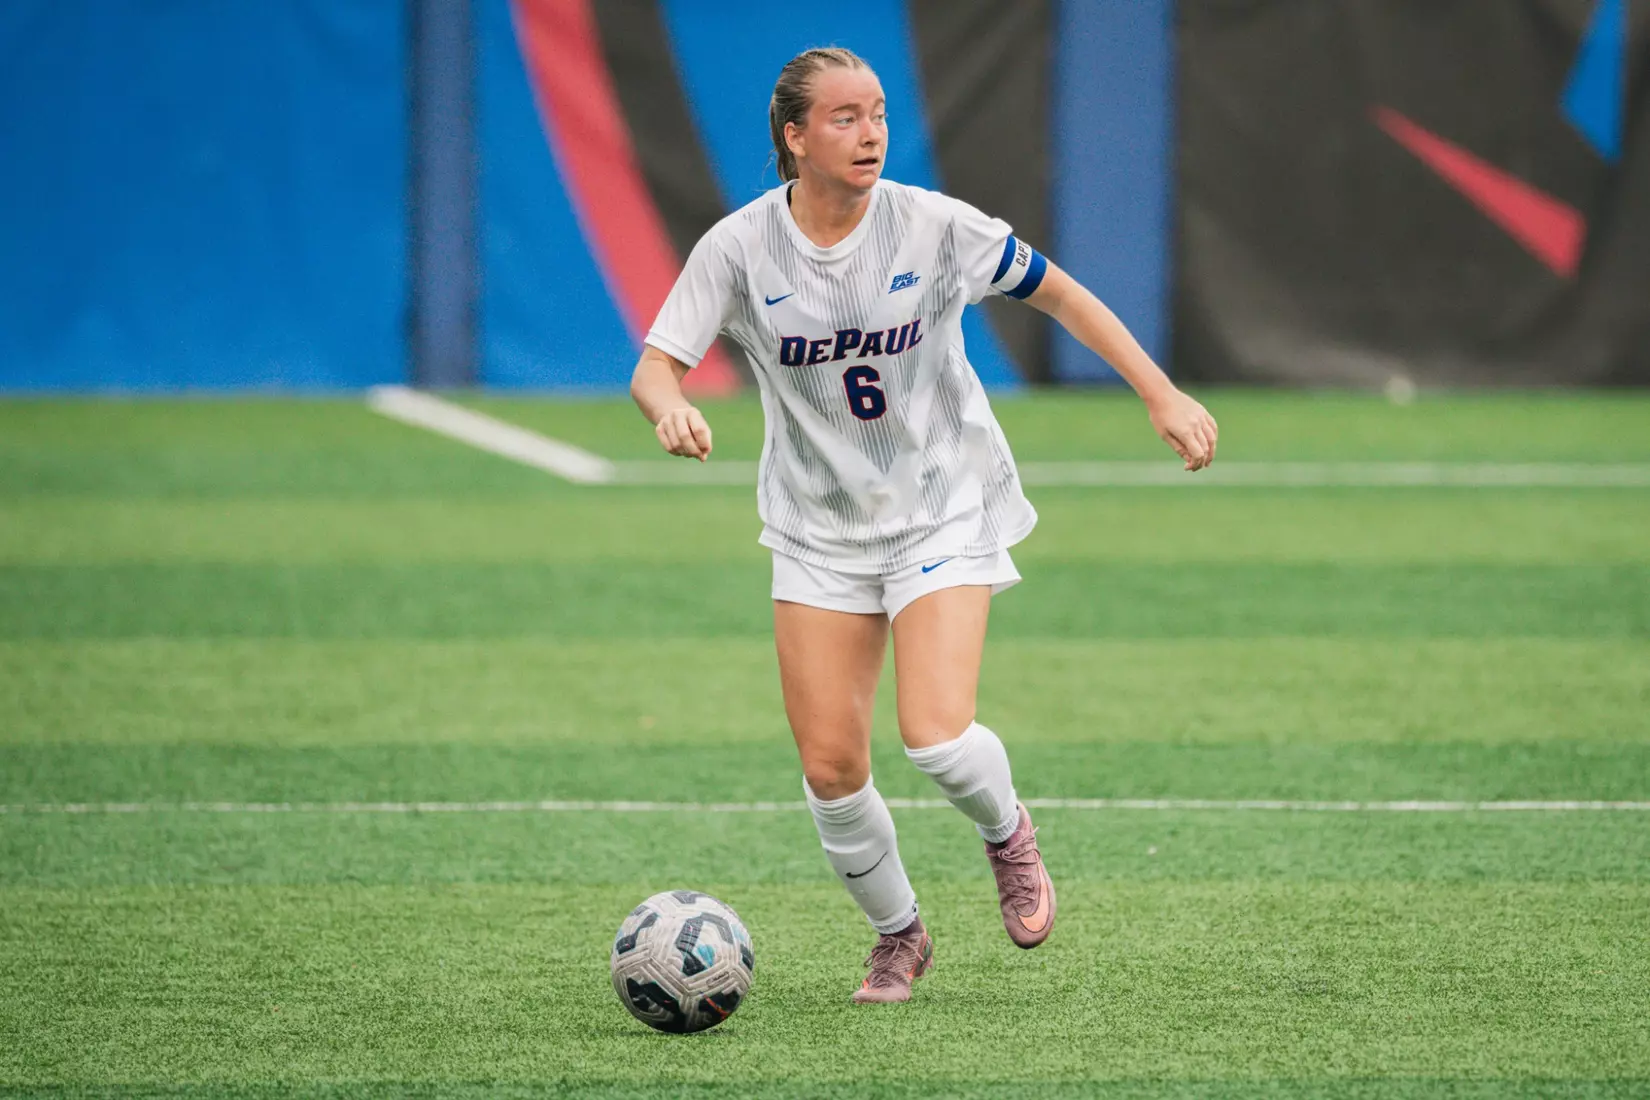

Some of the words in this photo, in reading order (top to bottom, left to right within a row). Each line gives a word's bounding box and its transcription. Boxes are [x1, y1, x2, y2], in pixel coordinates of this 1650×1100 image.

[890, 276, 921, 290] EAST
[892, 271, 914, 283] BIG
[842, 365, 887, 421] 6
